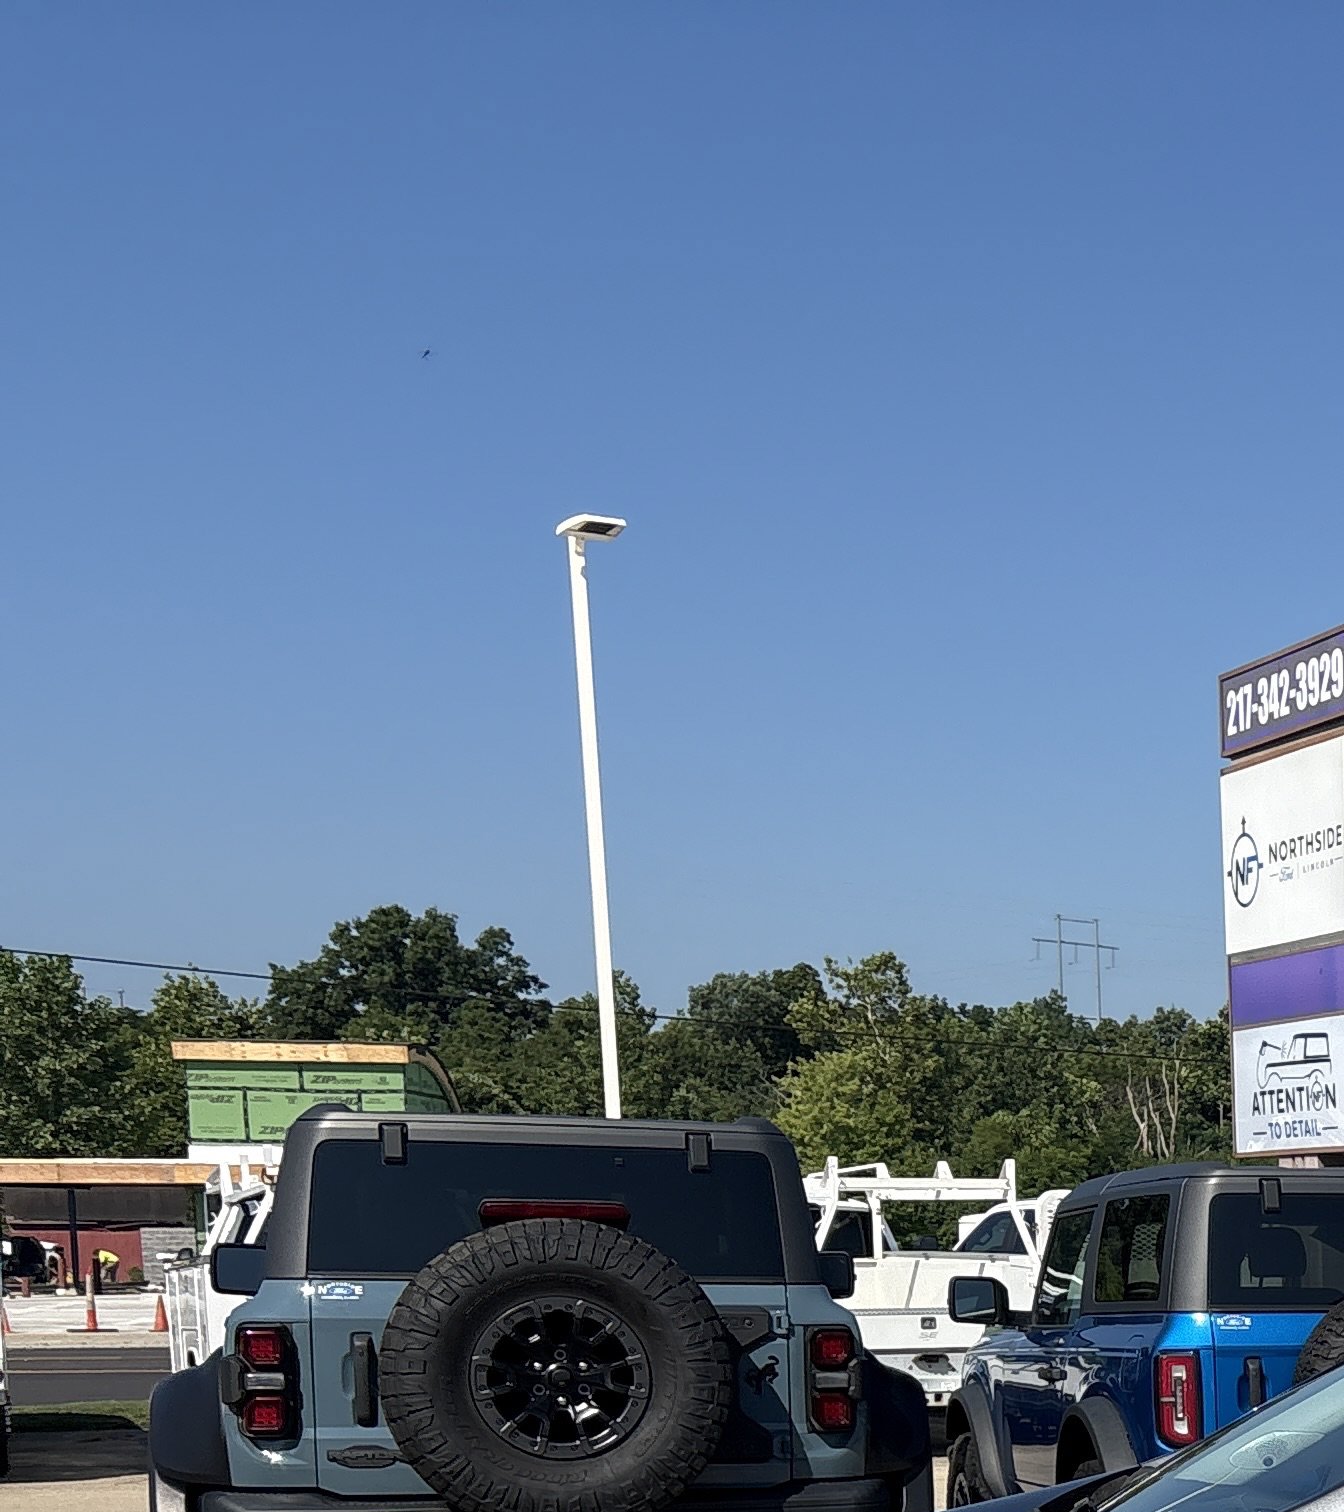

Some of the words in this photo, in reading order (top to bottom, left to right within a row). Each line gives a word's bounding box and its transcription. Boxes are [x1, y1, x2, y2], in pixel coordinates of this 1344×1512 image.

[1226, 648, 1344, 737] 217-342-3929
[1268, 824, 1343, 865] NORTHSIDE
[1302, 858, 1335, 874] LINCOLN
[1251, 1083, 1337, 1116] ATTENTION
[1267, 1123, 1283, 1139] TO
[1285, 1118, 1322, 1138] DETAIL
